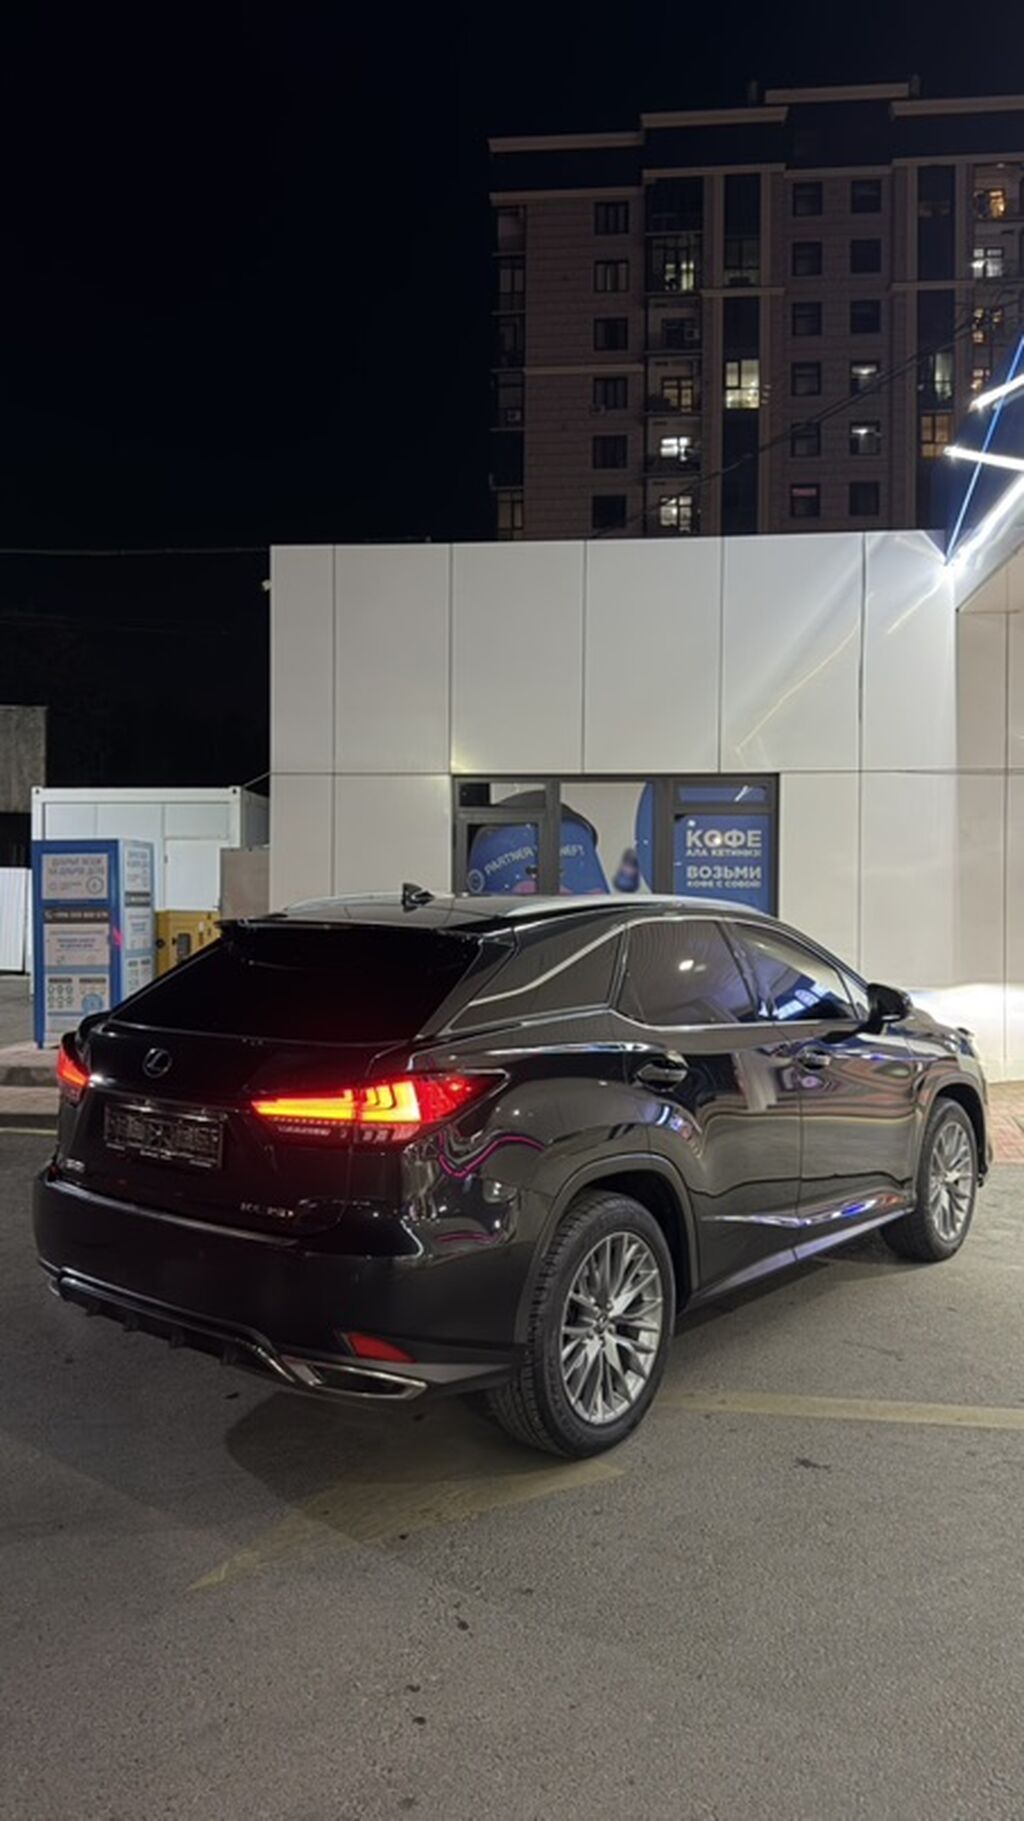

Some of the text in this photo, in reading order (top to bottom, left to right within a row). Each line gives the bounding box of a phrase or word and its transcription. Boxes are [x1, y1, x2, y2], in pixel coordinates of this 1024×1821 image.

[686, 829, 762, 847] КОФЕ
[685, 848, 708, 857] АЛА
[687, 866, 762, 879] ВОЗЬМИ
[687, 880, 714, 888] КОФЕ
